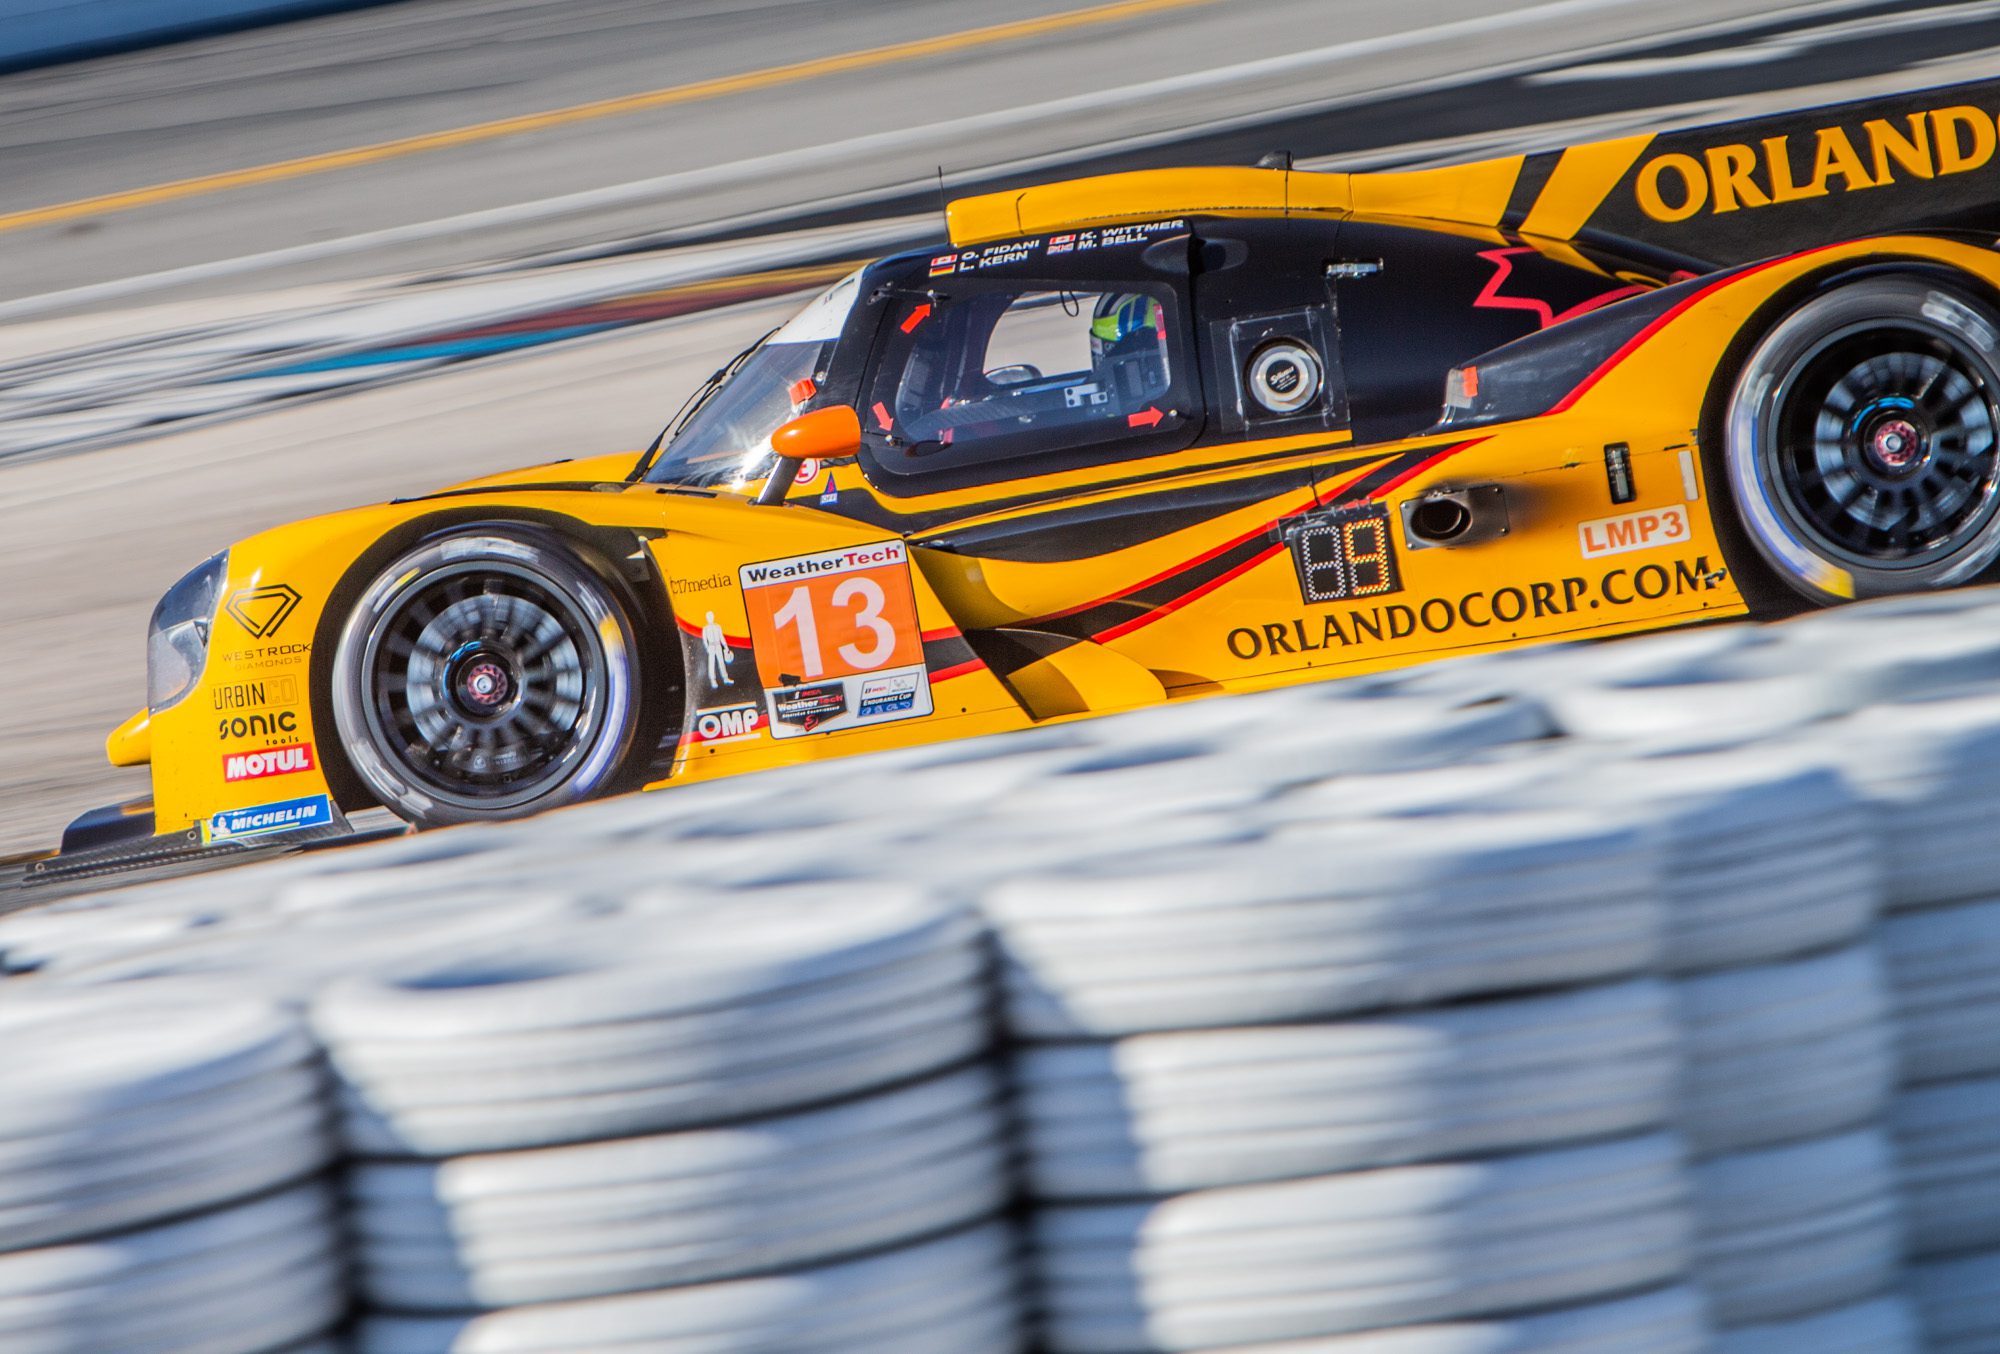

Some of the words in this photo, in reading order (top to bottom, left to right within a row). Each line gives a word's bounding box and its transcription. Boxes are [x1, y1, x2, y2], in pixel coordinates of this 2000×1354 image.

[1635, 105, 2000, 222] ORLAND
[1077, 240, 1098, 250] M.
[1102, 232, 1148, 247] BELL
[1080, 231, 1097, 241] K.
[1102, 219, 1184, 237] WITTMER
[959, 261, 975, 273] L.
[979, 250, 1029, 269] KERN
[961, 251, 980, 261] O.
[983, 240, 1040, 257] FIDANI
[1583, 511, 1685, 553] LMP3
[747, 546, 900, 583] WeatherTech
[1227, 556, 1718, 660] ORLANDOCORP.COM
[773, 577, 896, 678] 13
[223, 643, 312, 662] WESTROCK
[234, 656, 302, 672] DIAMONDS
[698, 709, 759, 739] OMP
[266, 735, 299, 747] tools
[226, 748, 309, 779] MOTUL
[231, 804, 318, 830] MICHELIN
